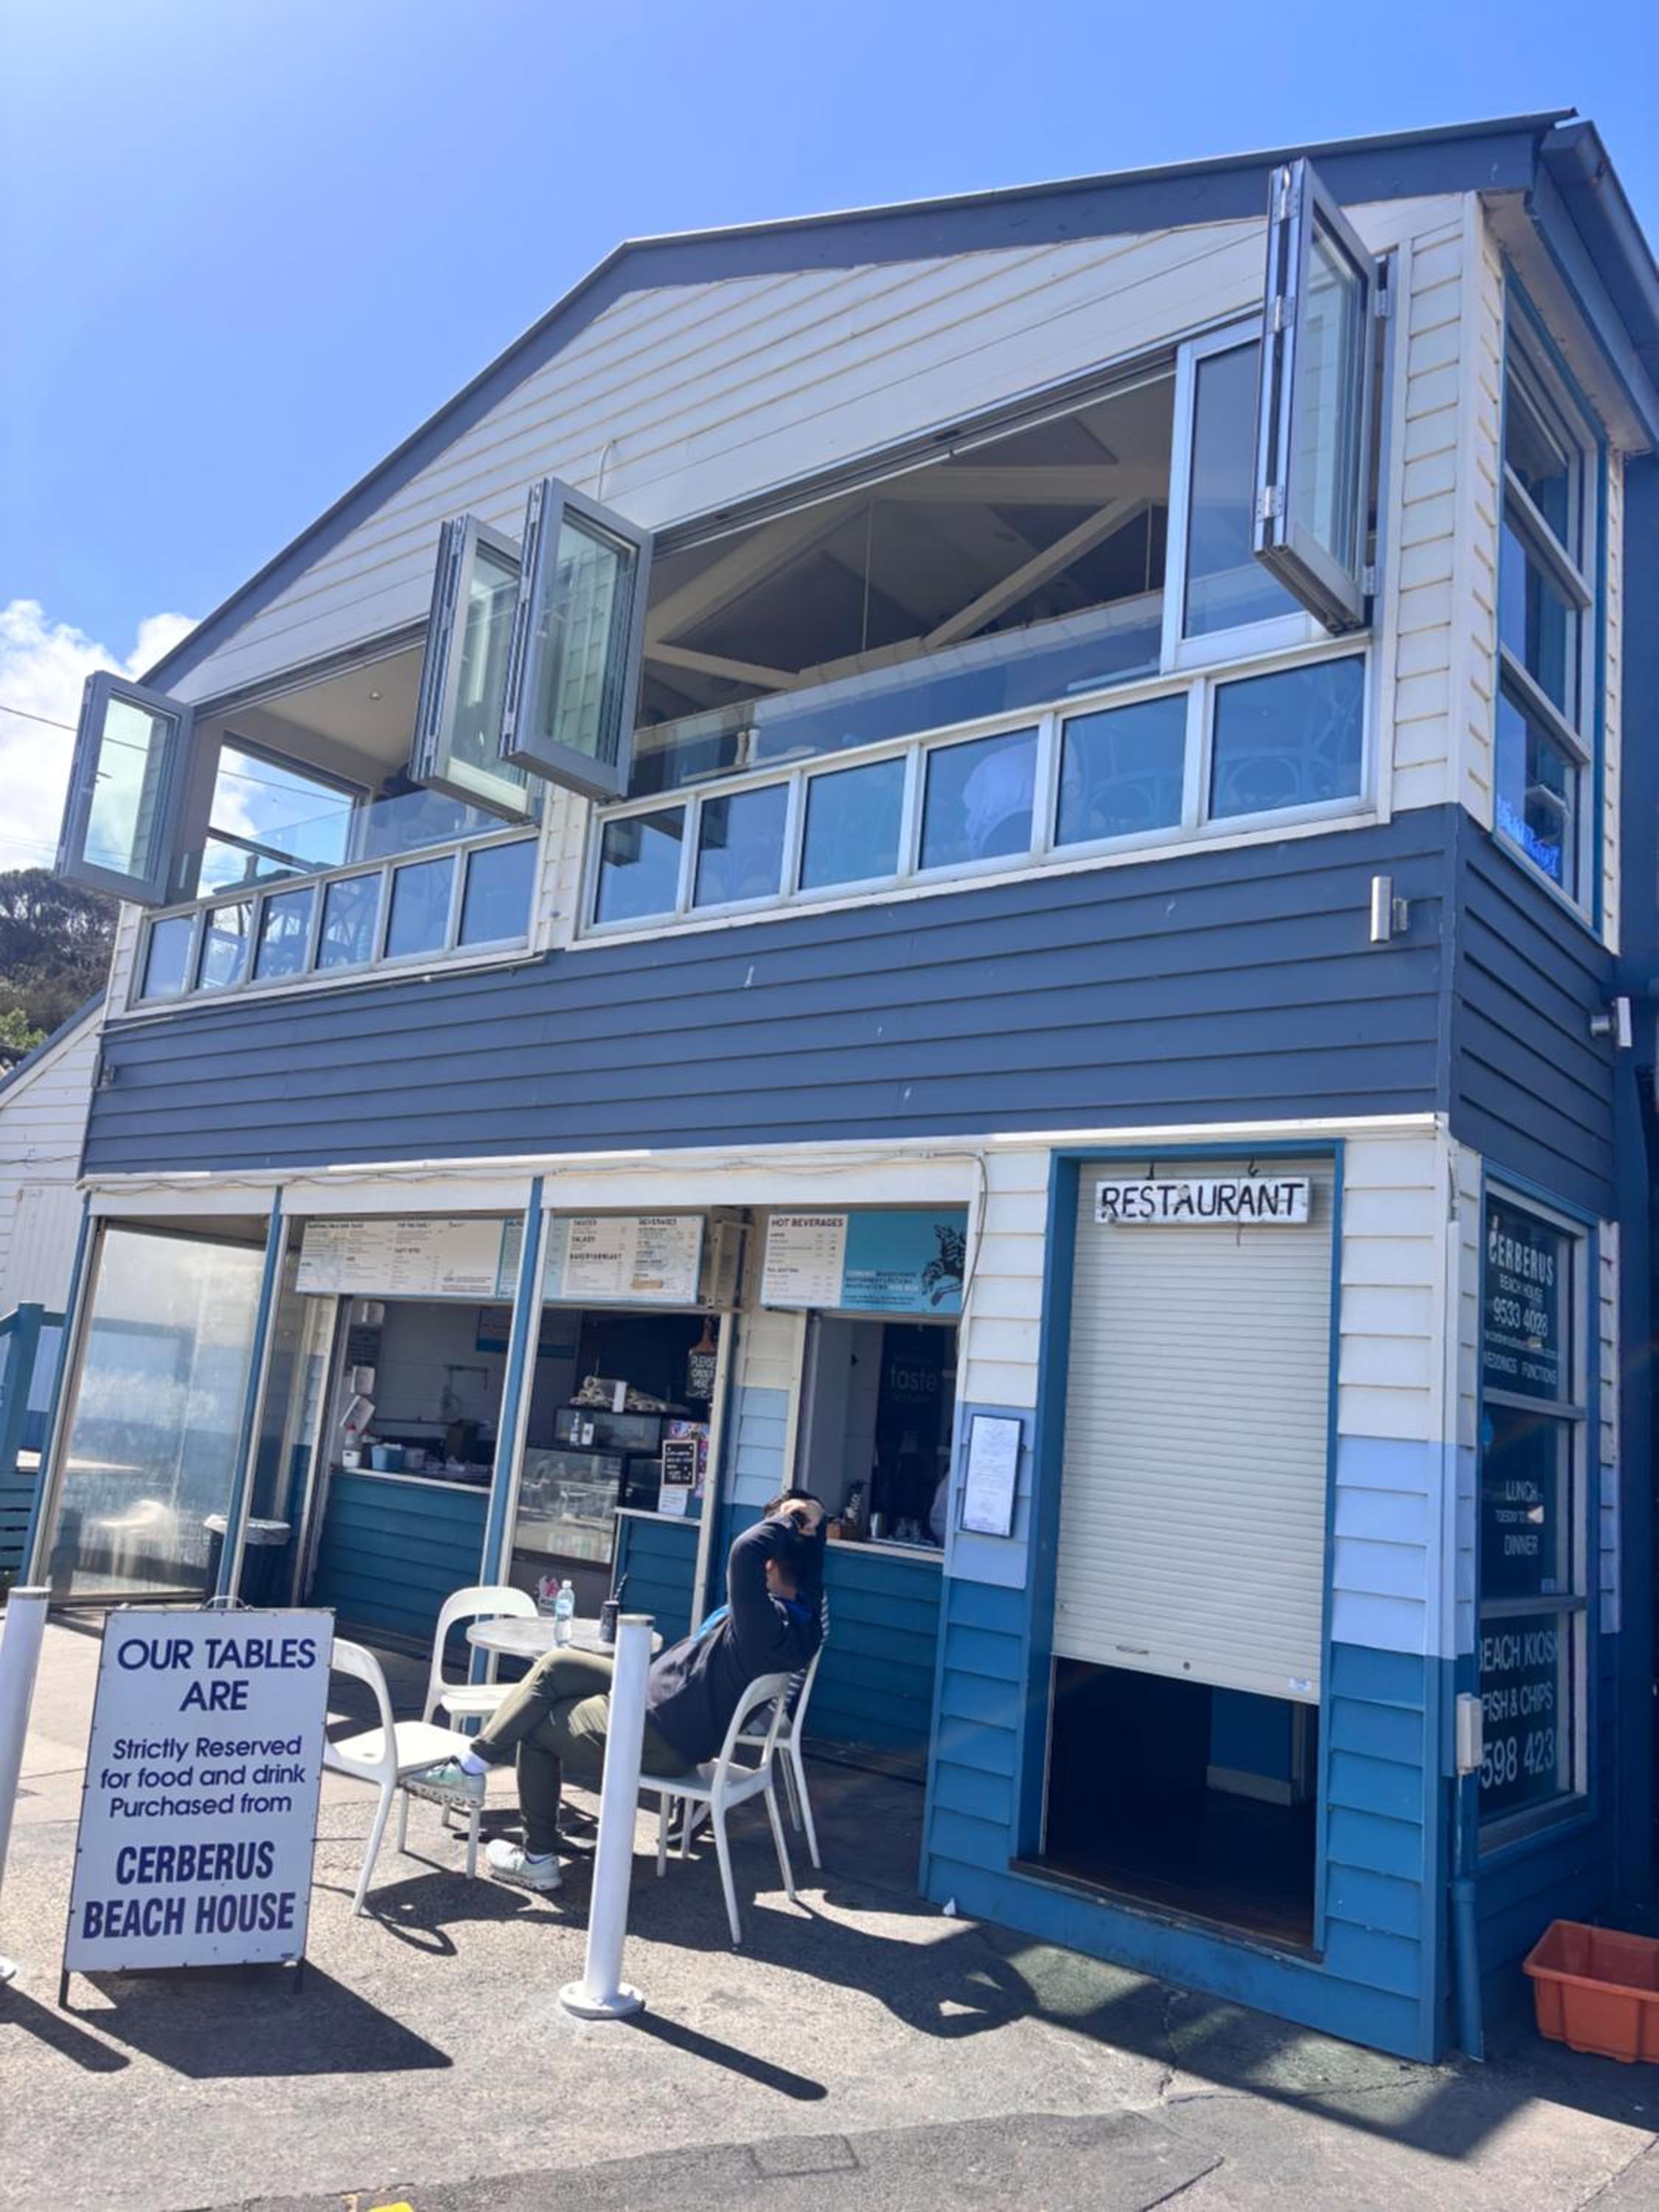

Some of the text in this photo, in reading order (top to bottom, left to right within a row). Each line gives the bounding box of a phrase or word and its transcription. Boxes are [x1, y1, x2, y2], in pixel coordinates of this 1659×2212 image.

[1102, 1183, 1304, 1217] RESTAURANT
[771, 1217, 844, 1228] HOT BEVERAGES
[1488, 1230, 1554, 1287] CERBERUS
[1499, 1273, 1543, 1303] BEACH HOUSE
[1493, 1296, 1520, 1329] 9533
[1506, 1480, 1538, 1502] LUNCH
[1503, 1534, 1538, 1557] DINNER
[117, 1638, 316, 1670] OUR TABLES
[178, 1680, 249, 1711] ARE
[1481, 1680, 1554, 1723] FISH & CHIPS
[113, 1735, 302, 1762] Strictly Reserved
[100, 1763, 306, 1789] for food and drink
[110, 1792, 292, 1818] Purchased from
[116, 1840, 275, 1885] CERBERUS
[83, 1892, 296, 1939] BEACH HOUSE
